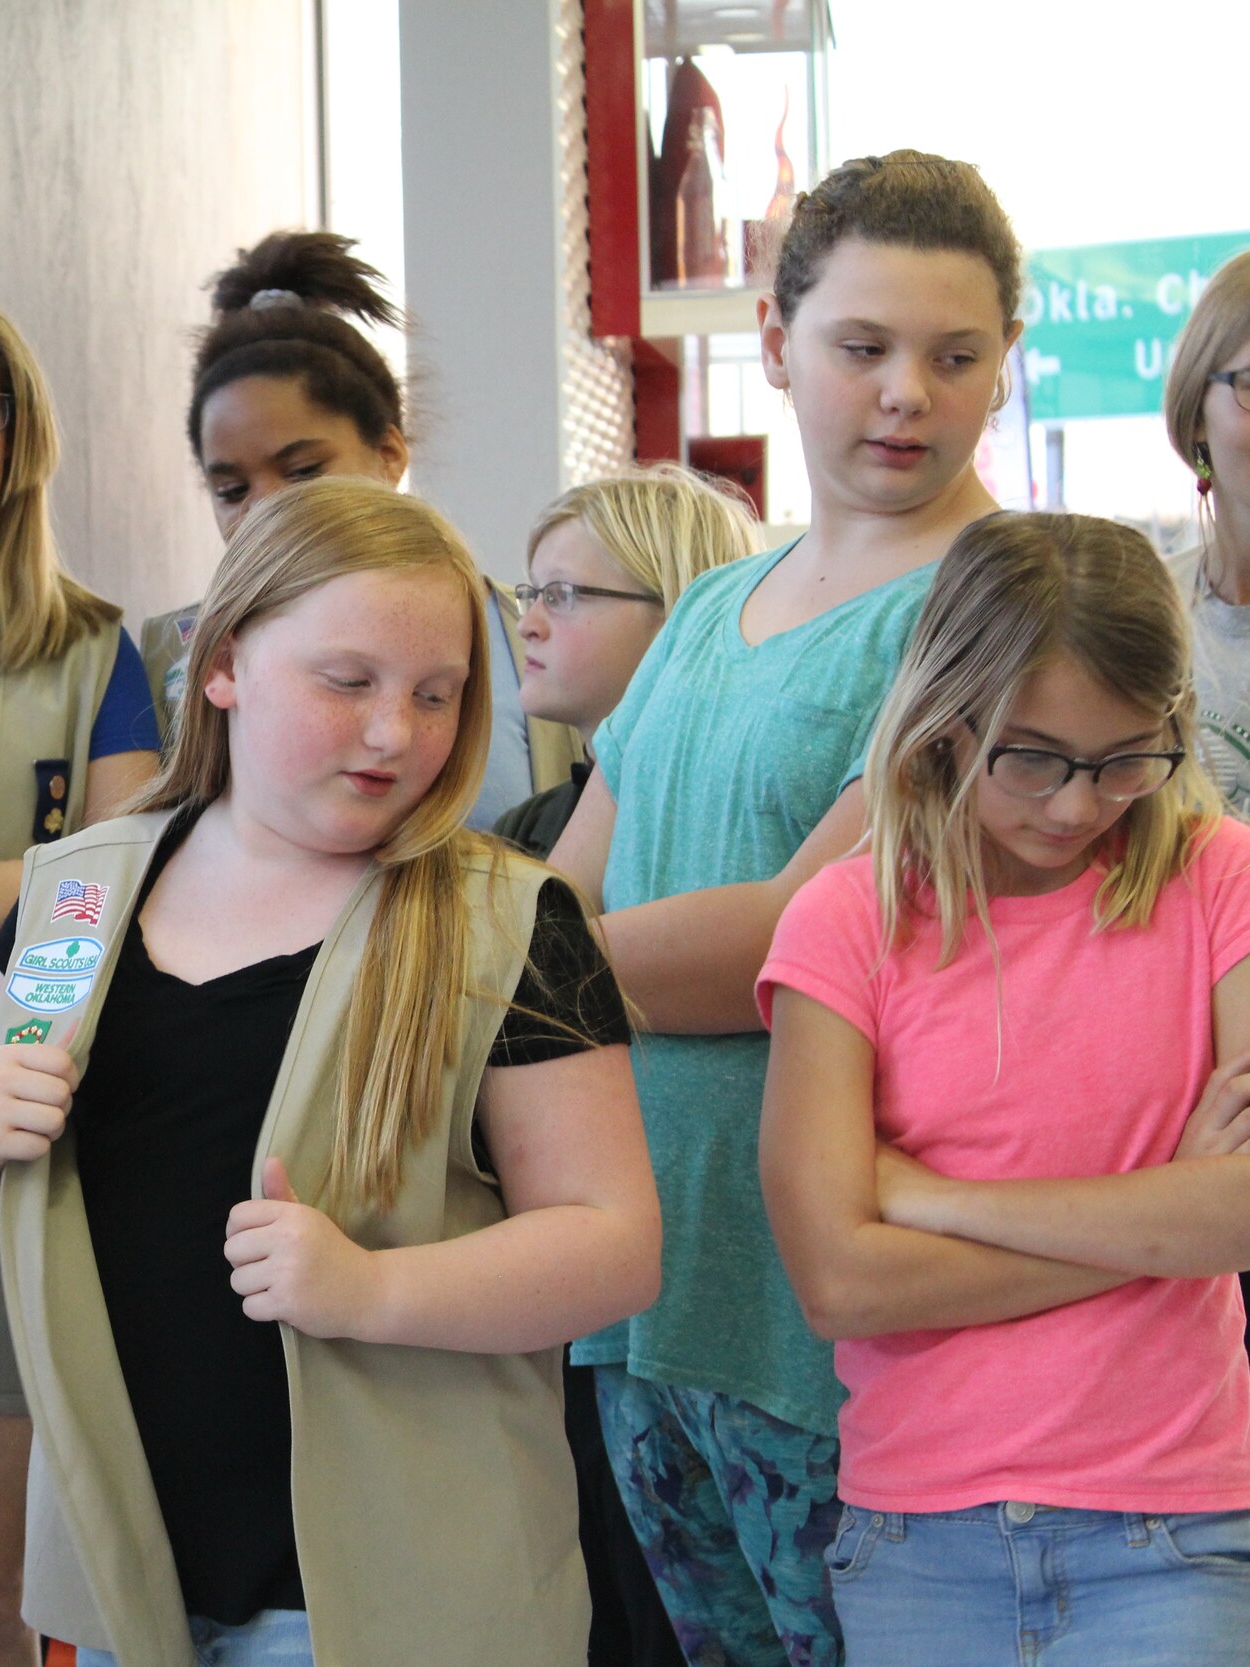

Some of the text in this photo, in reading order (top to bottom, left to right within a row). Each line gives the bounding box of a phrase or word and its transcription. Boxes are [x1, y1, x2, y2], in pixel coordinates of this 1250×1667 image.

[25, 954, 47, 967] GIRL
[50, 957, 85, 968] SCOUTS
[36, 983, 76, 993] WESTERN
[25, 992, 75, 1004] OKLAHOMA
